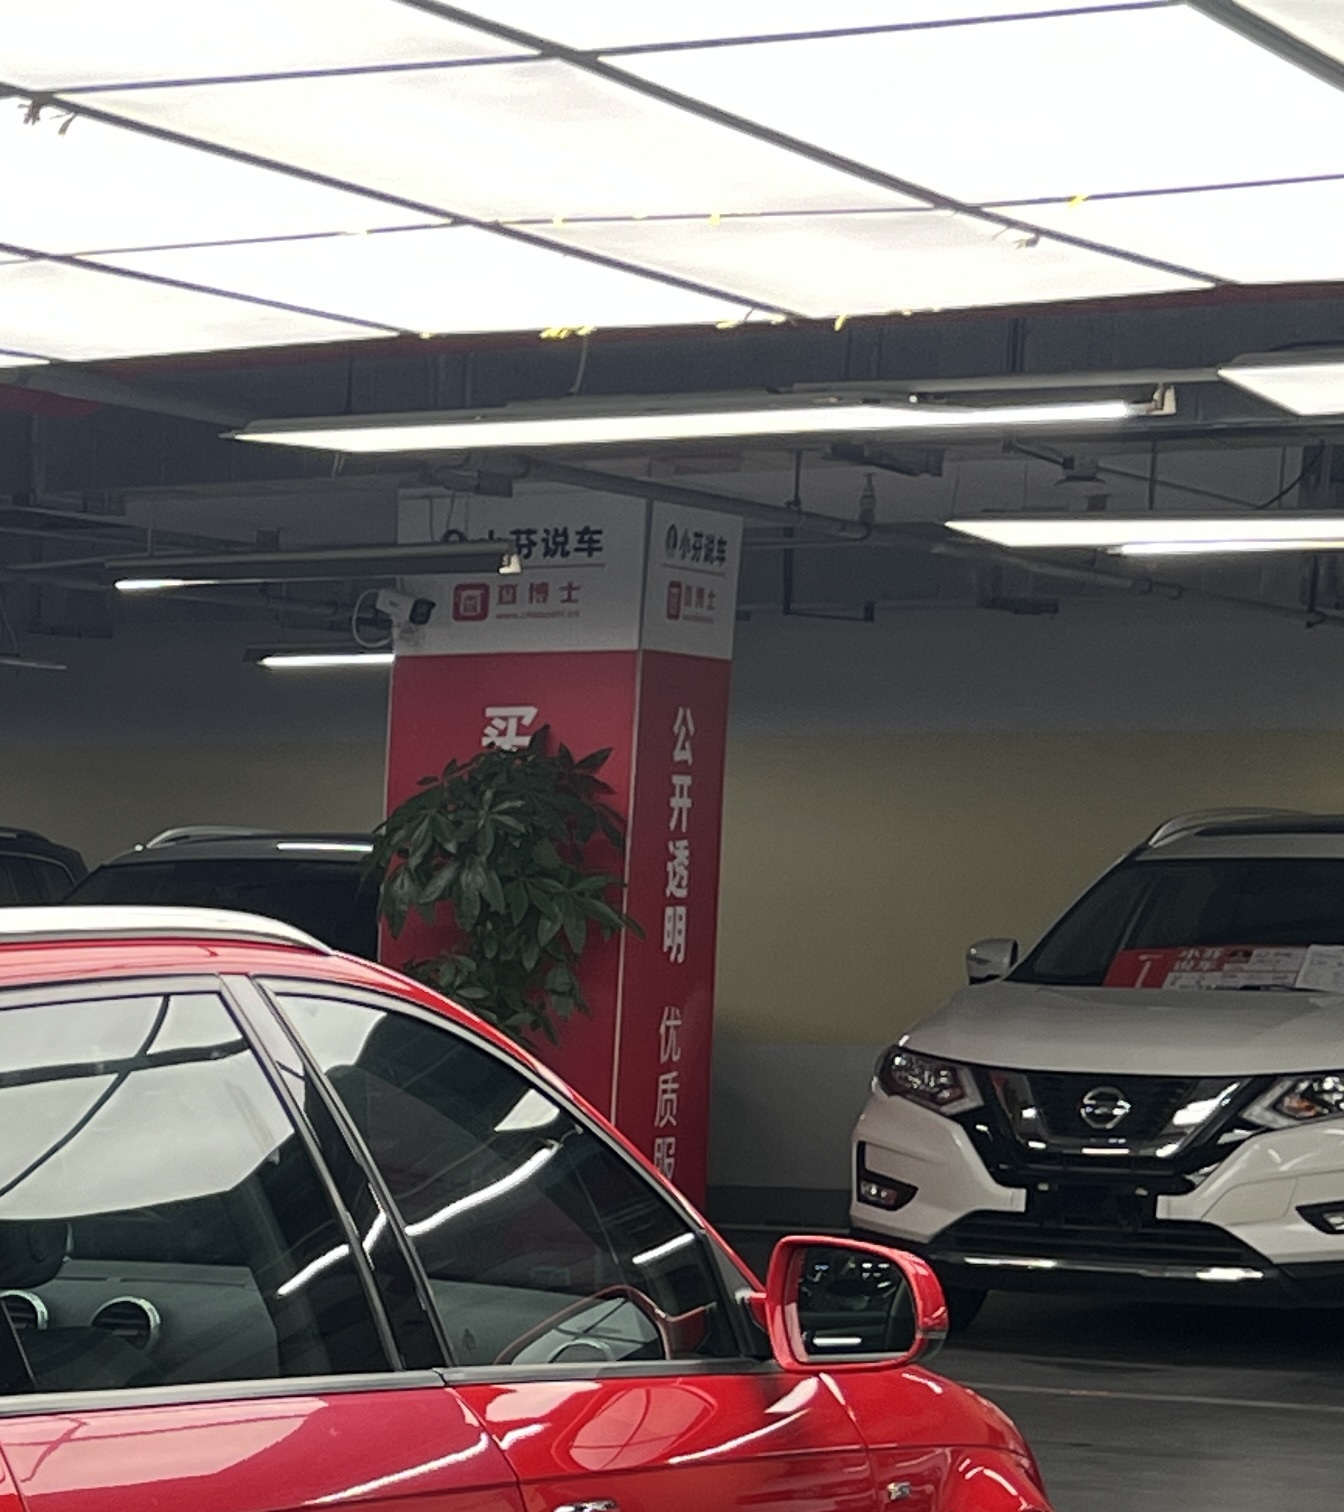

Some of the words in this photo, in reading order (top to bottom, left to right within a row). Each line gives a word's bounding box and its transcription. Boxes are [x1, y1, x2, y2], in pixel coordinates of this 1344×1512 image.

[487, 525, 604, 560] 芬说车
[662, 706, 696, 964] 公开透明
